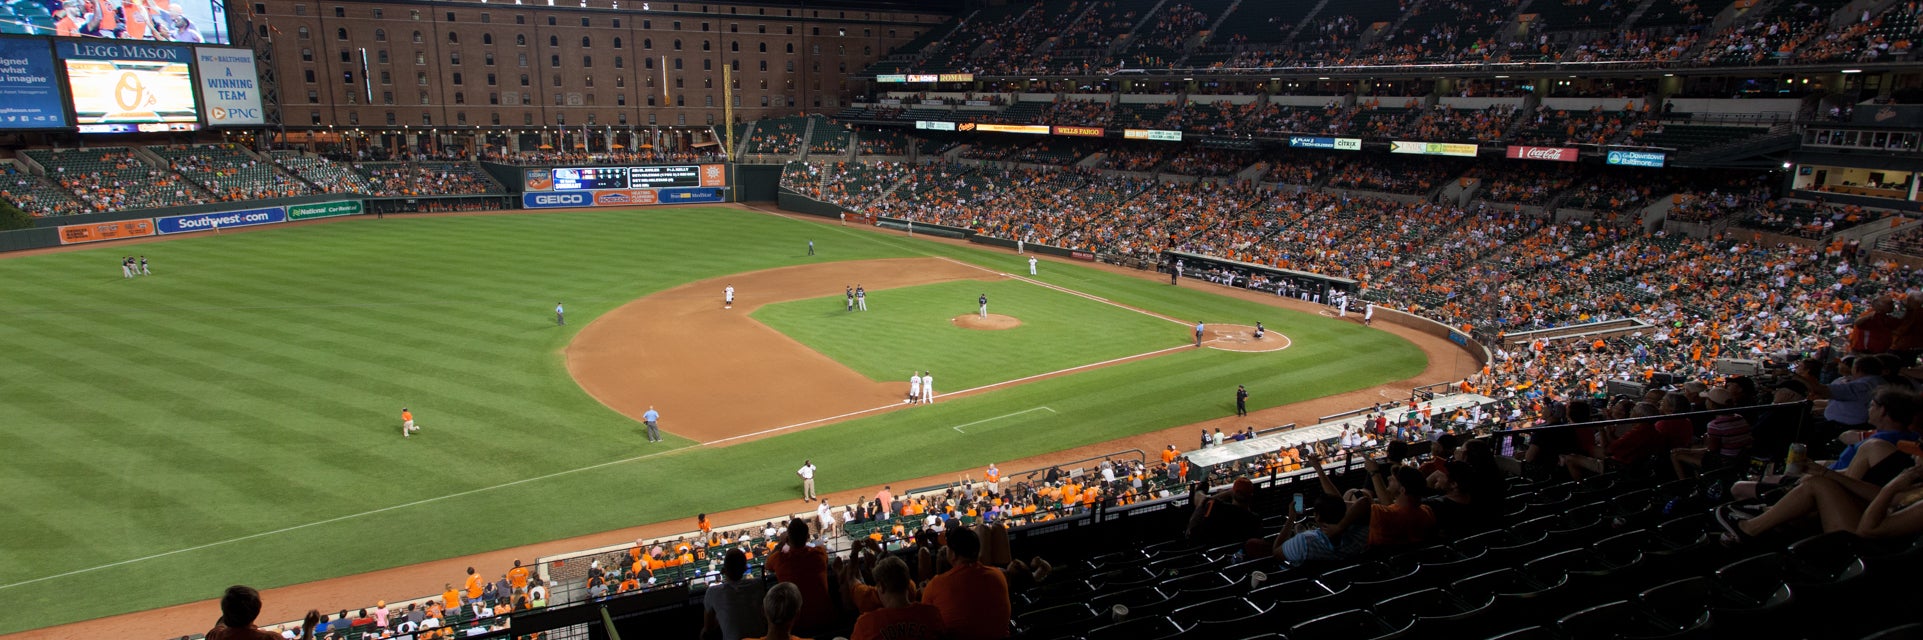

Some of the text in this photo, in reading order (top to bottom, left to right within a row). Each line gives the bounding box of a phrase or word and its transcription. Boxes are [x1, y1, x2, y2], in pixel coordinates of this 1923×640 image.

[73, 43, 177, 59] LEGG MASON
[225, 67, 232, 77] A
[6, 75, 47, 84] imagine
[940, 74, 964, 82] ROMA
[207, 78, 253, 89] WINNING
[217, 91, 247, 101] TEAM
[228, 108, 259, 119] PNC
[1058, 127, 1099, 136] WELLS FARGO
[535, 194, 583, 205] GEICO
